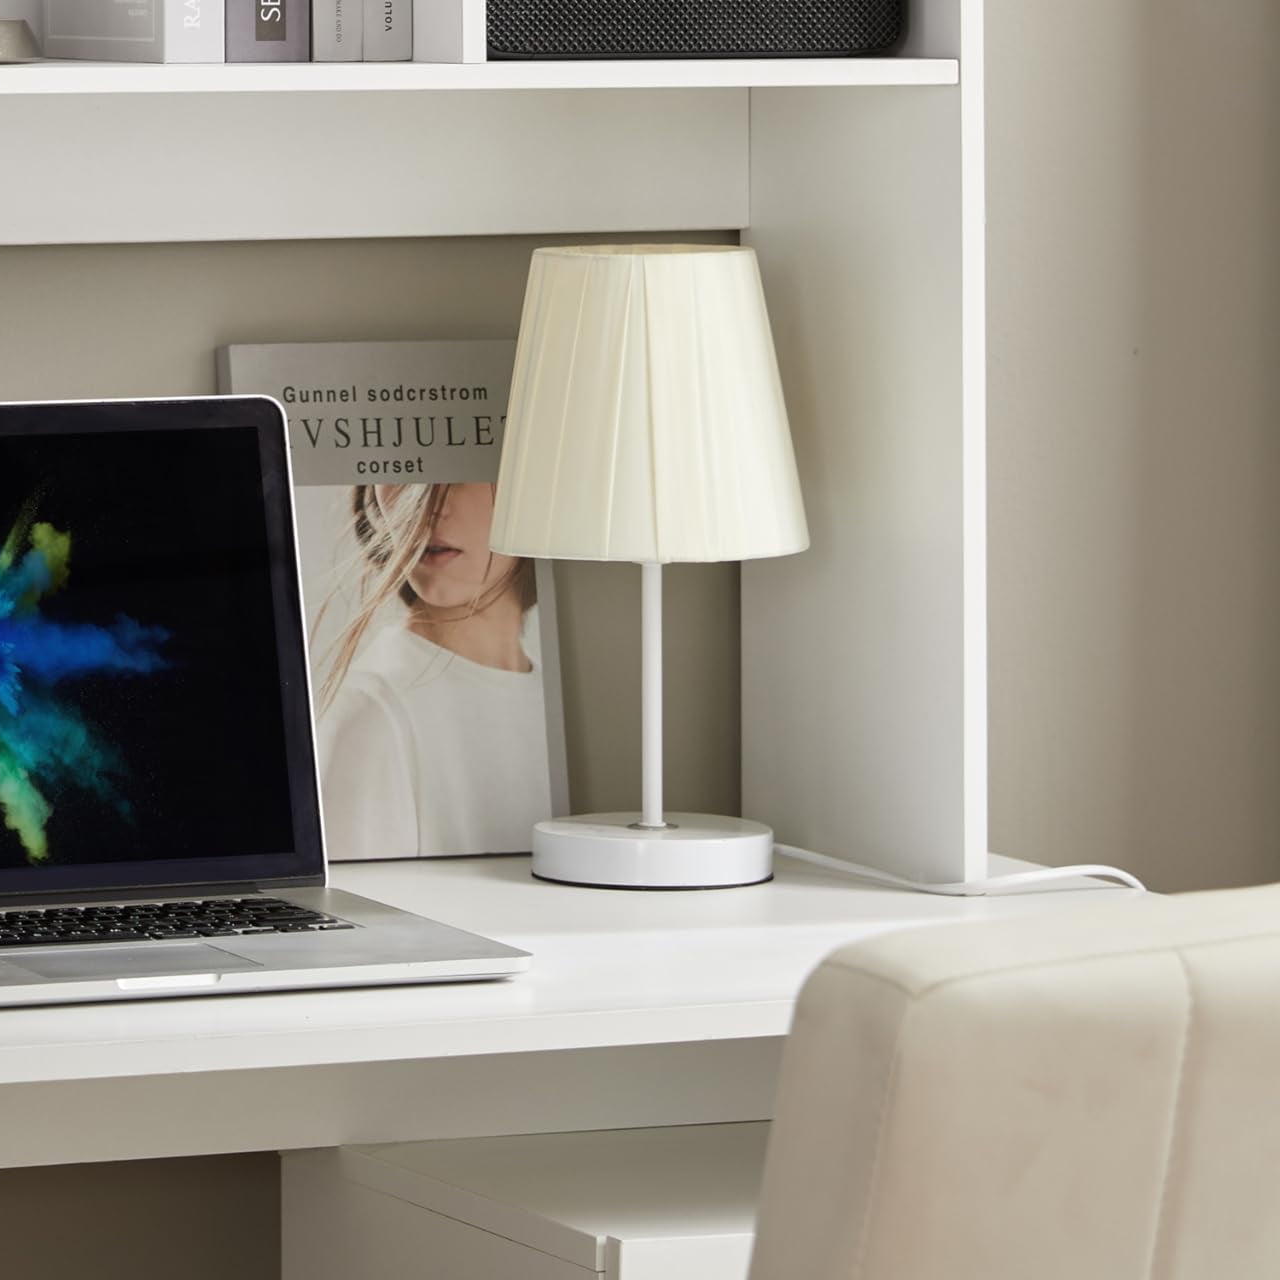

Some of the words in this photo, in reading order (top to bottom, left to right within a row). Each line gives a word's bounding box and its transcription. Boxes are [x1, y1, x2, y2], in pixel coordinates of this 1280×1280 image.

[283, 385, 357, 403] Gunnel
[288, 415, 507, 449] VSHJULE
[357, 457, 423, 474] corset
